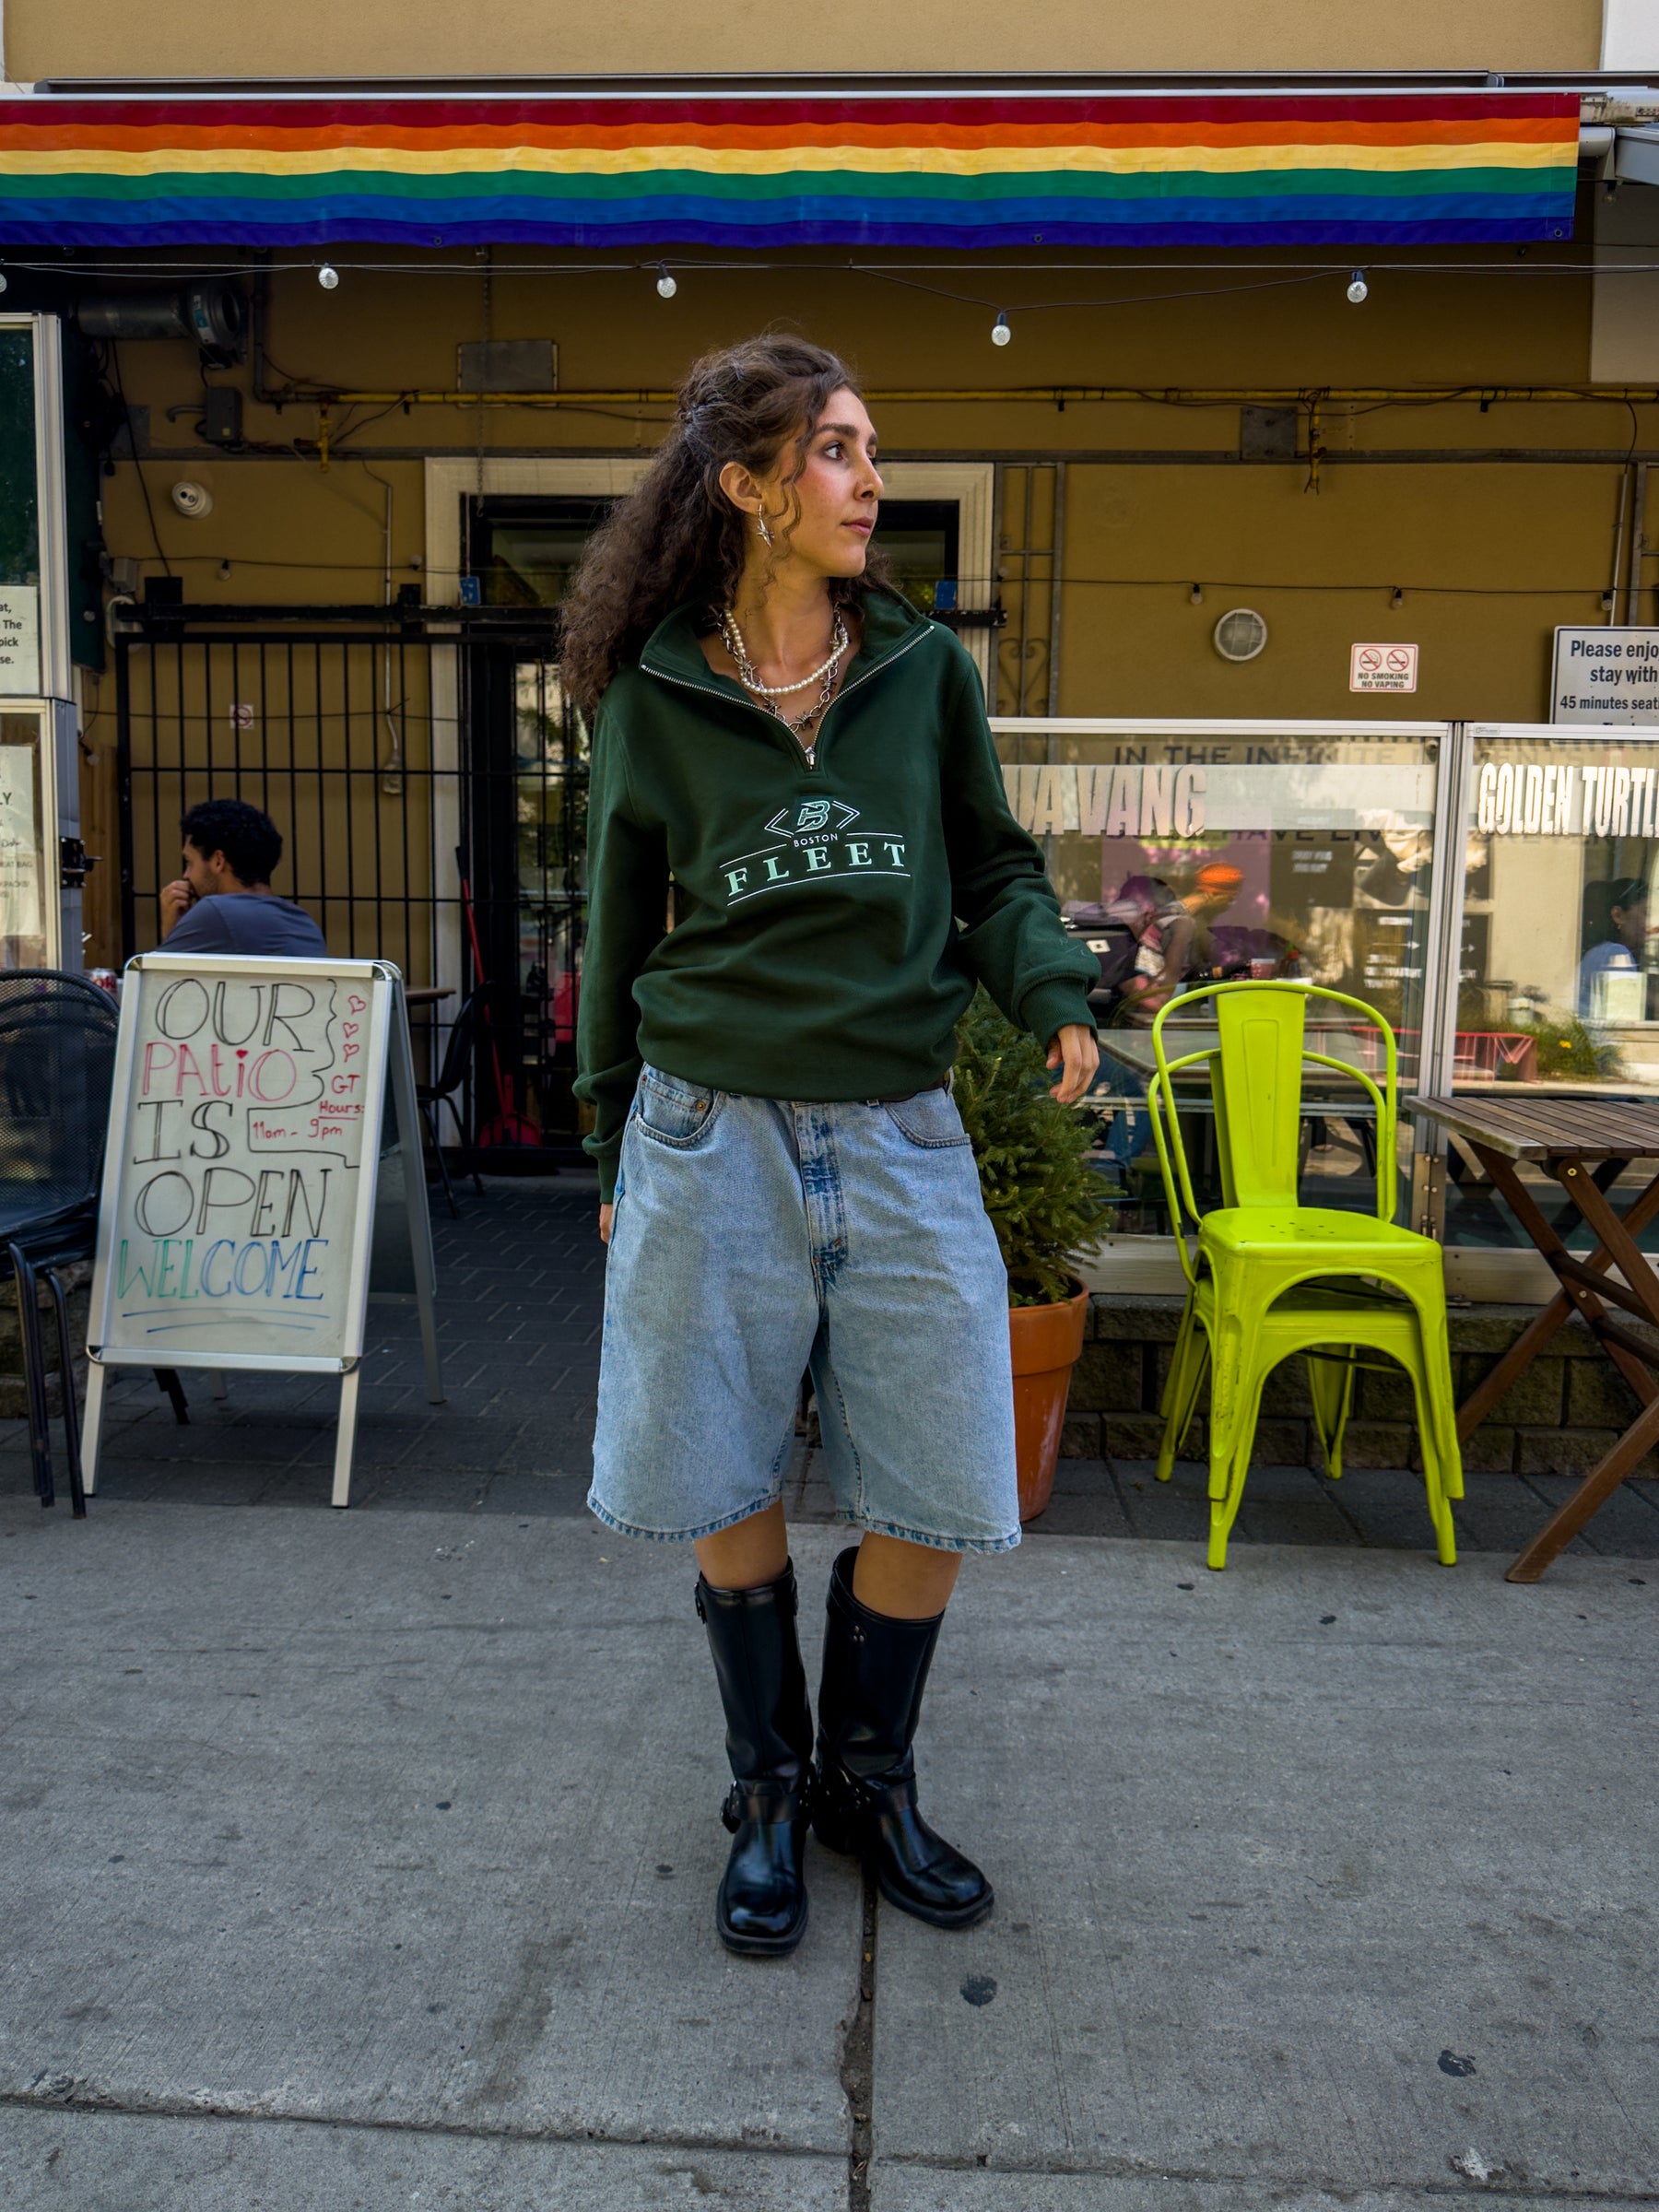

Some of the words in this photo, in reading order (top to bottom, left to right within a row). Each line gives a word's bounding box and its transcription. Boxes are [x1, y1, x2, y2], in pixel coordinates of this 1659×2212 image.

[3, 619, 22, 629] The
[1571, 640, 1622, 657] Please
[1627, 641, 1659, 661] enjo
[1590, 665, 1622, 686] stay
[1626, 665, 1658, 683] with
[1559, 696, 1576, 709] 45
[1579, 696, 1629, 710] minutes
[1630, 696, 1659, 710] seat
[1114, 746, 1147, 765] IN
[1163, 746, 1232, 765] THE
[1477, 762, 1574, 835] GOLDEN
[1582, 766, 1659, 838] TURTL
[794, 833, 839, 848] BOSTON
[724, 841, 906, 898] FLEET
[155, 978, 315, 1053] OUR
[331, 1074, 360, 1095] GT
[134, 1100, 232, 1164] IS
[308, 1118, 343, 1141] 9pm
[135, 1167, 333, 1238] OPEN
[117, 1239, 329, 1300] WELCOME
